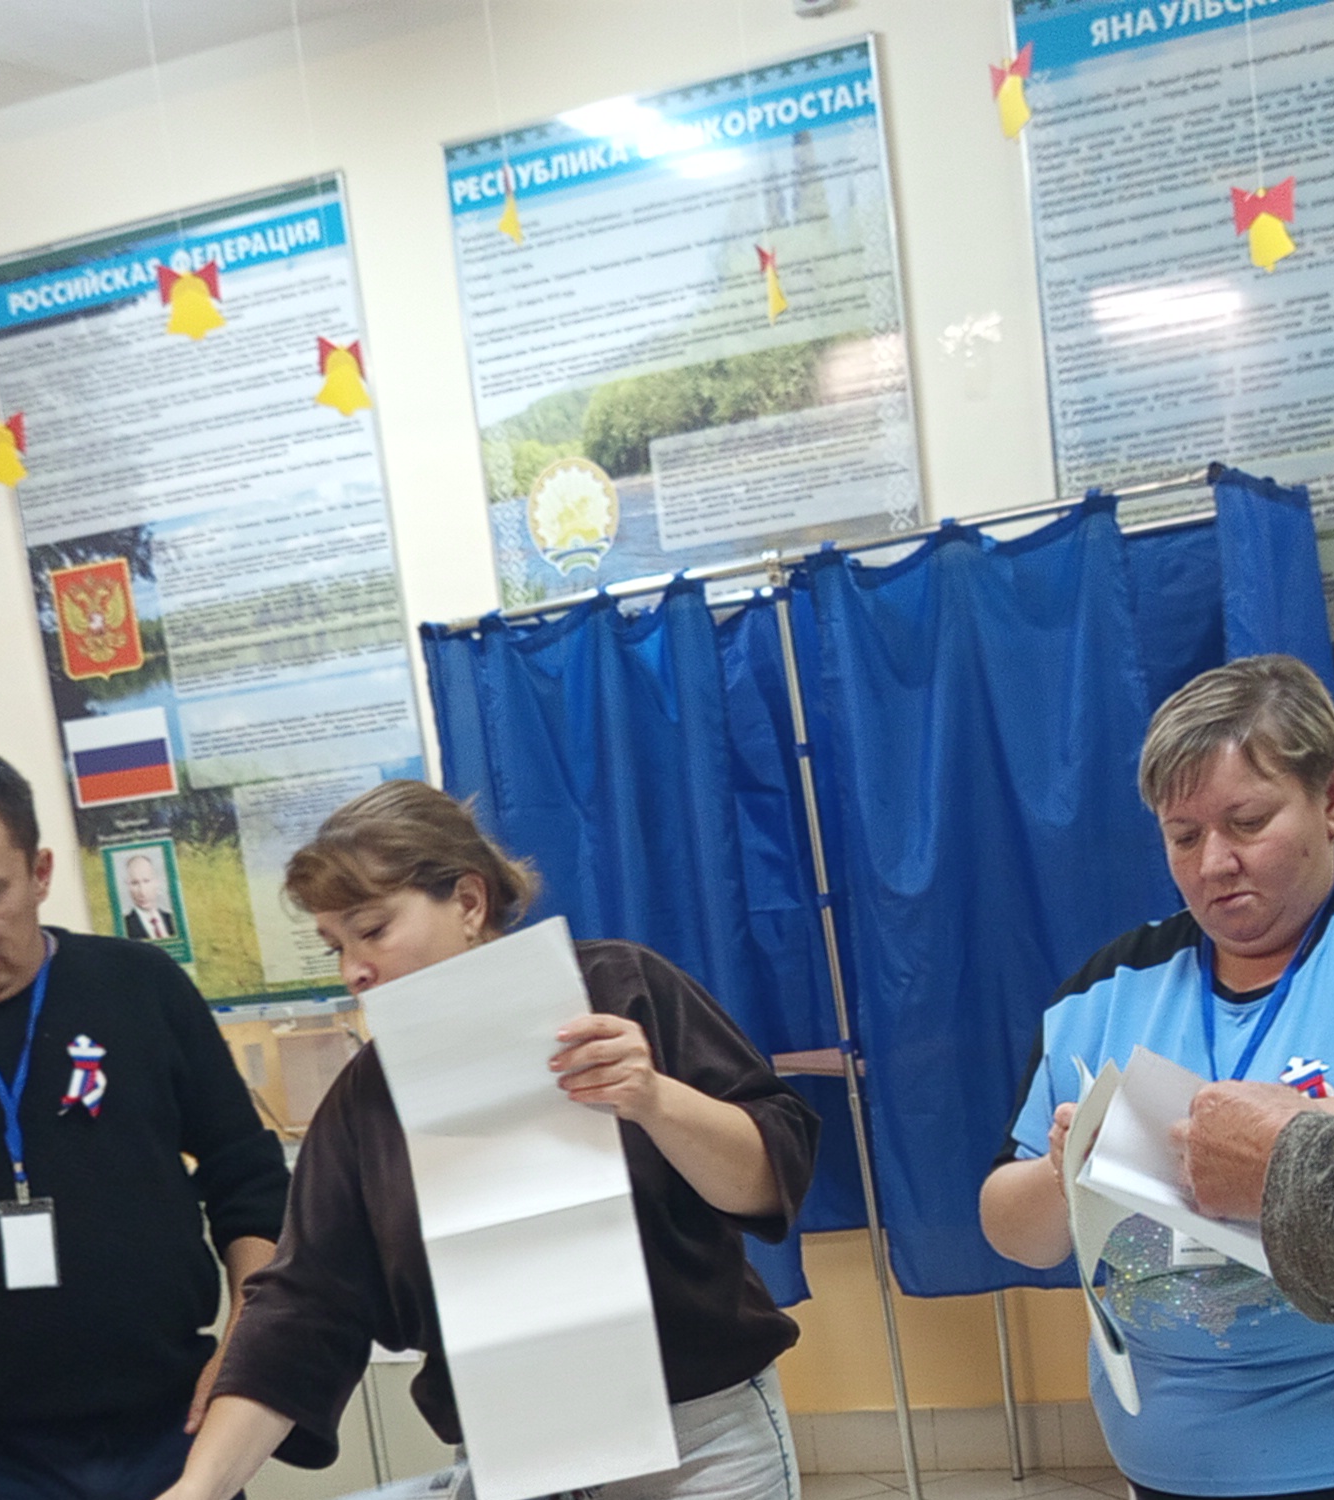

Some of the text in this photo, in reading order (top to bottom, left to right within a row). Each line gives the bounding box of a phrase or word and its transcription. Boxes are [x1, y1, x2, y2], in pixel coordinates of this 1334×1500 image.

[1090, 0, 1278, 46] ЯНАУЛЬС
[452, 79, 875, 206] РЕСПУБЛИКА КОРТОСТАН
[7, 217, 322, 316] РОССИЙСКАЯ ФЕДЕРАЦИЯ
